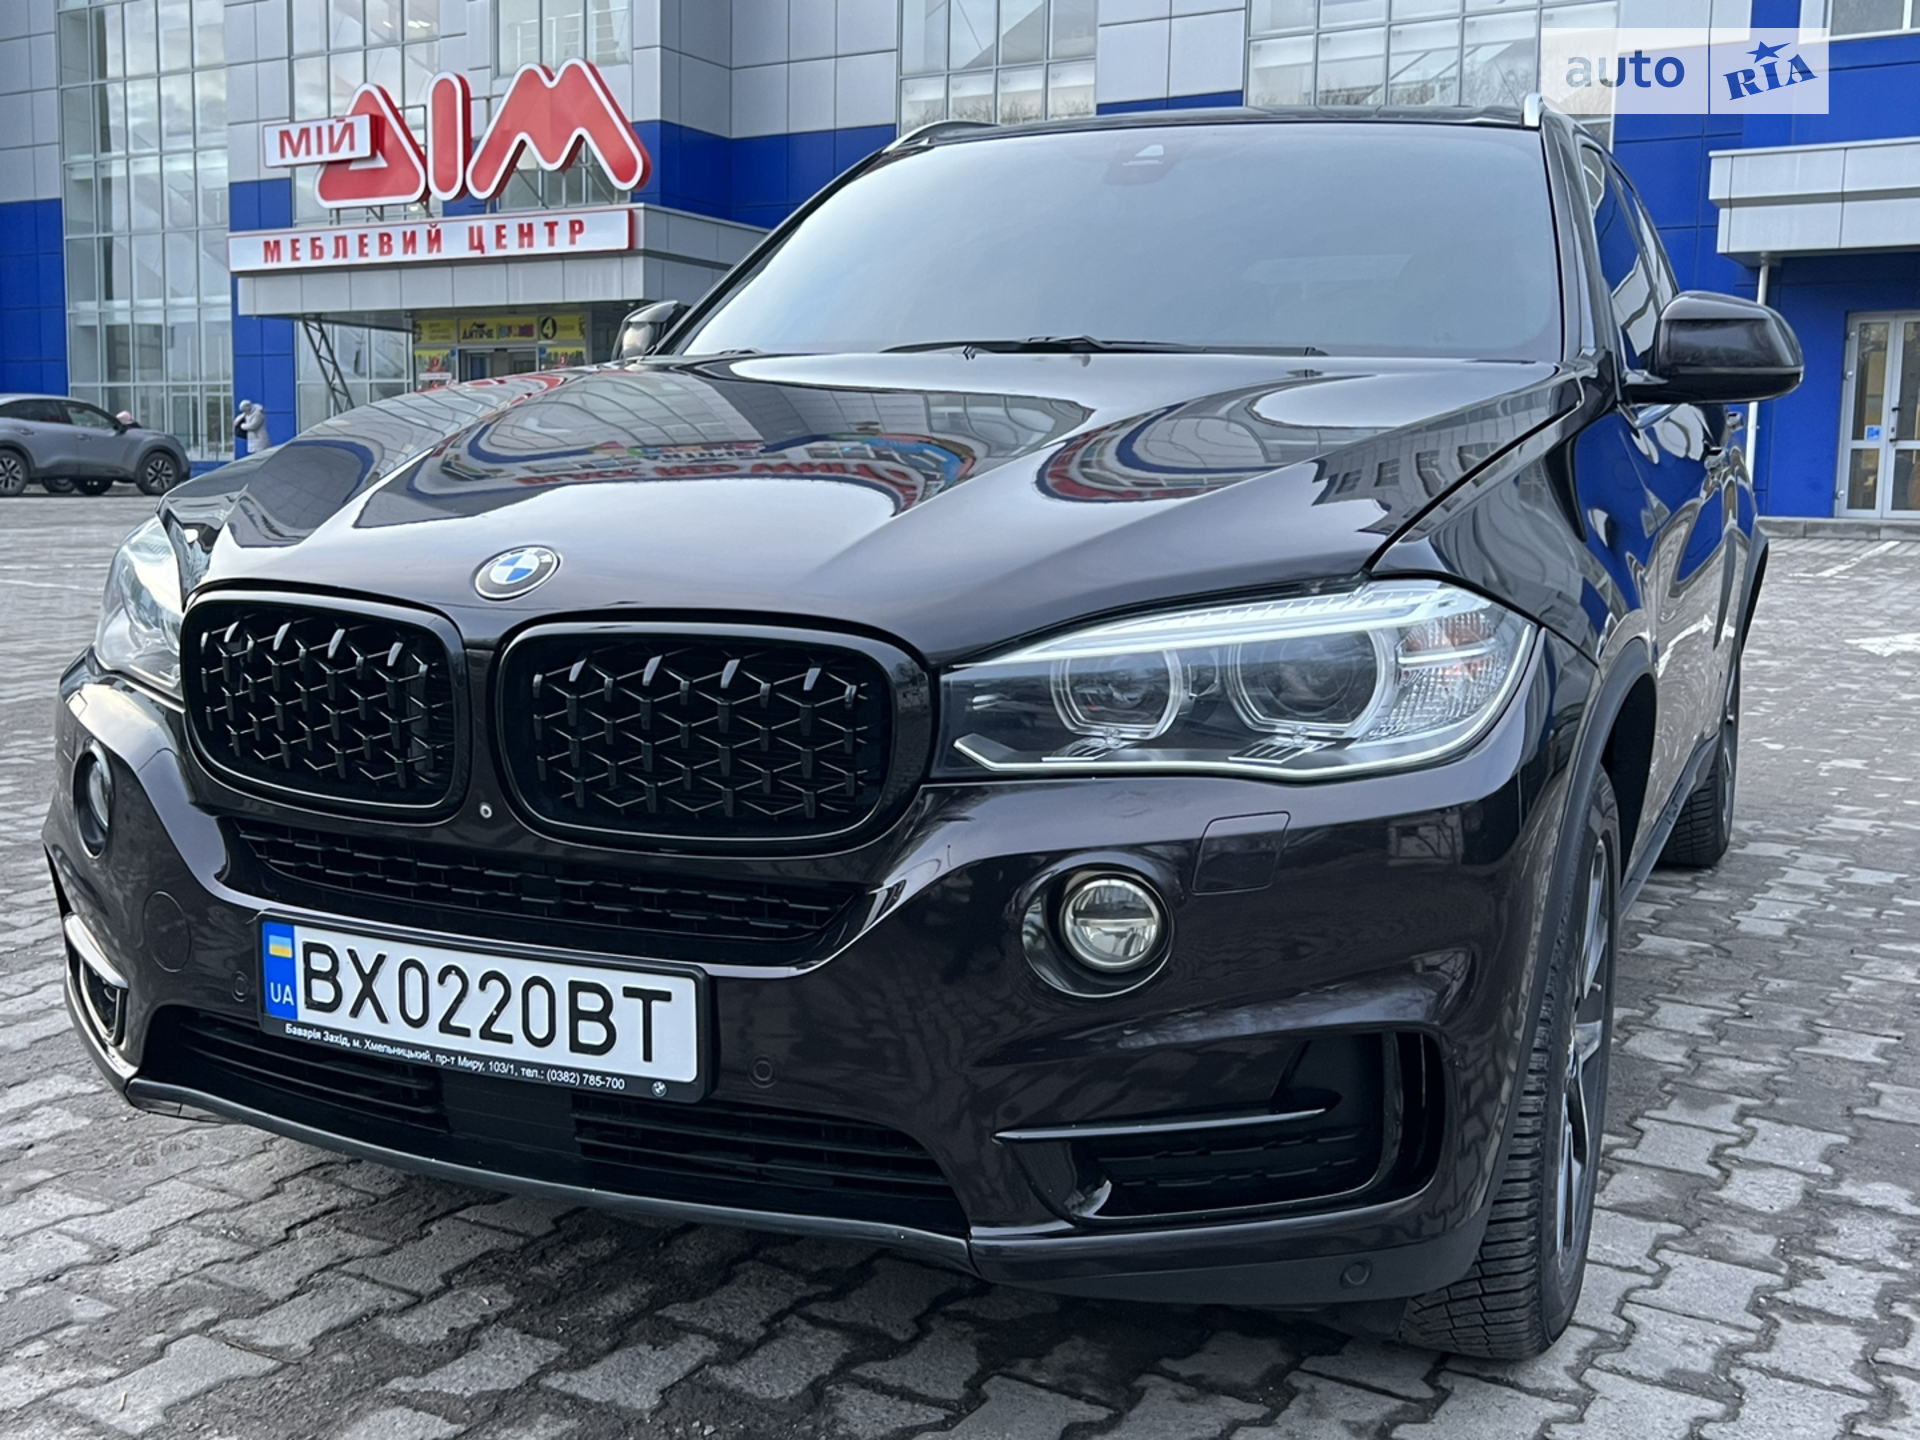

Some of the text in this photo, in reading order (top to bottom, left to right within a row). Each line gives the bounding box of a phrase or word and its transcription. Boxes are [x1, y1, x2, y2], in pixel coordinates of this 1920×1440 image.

[278, 118, 356, 160] МІЙ
[315, 57, 650, 209] ДІМ
[263, 219, 586, 265] МЕБЛЕВИЙ ЦЕНТР
[270, 940, 672, 1063] UA BX0220BT
[285, 1023, 322, 1041] Баварія
[323, 1031, 351, 1047] Захід,
[352, 1040, 362, 1049] м.
[364, 1039, 433, 1063] Хмельницький,
[435, 1053, 455, 1067] пр-т
[457, 1056, 486, 1072] Миру,
[488, 1061, 518, 1077] 103/1,
[546, 1070, 580, 1087] (0382)
[582, 1073, 626, 1091] 785-700
